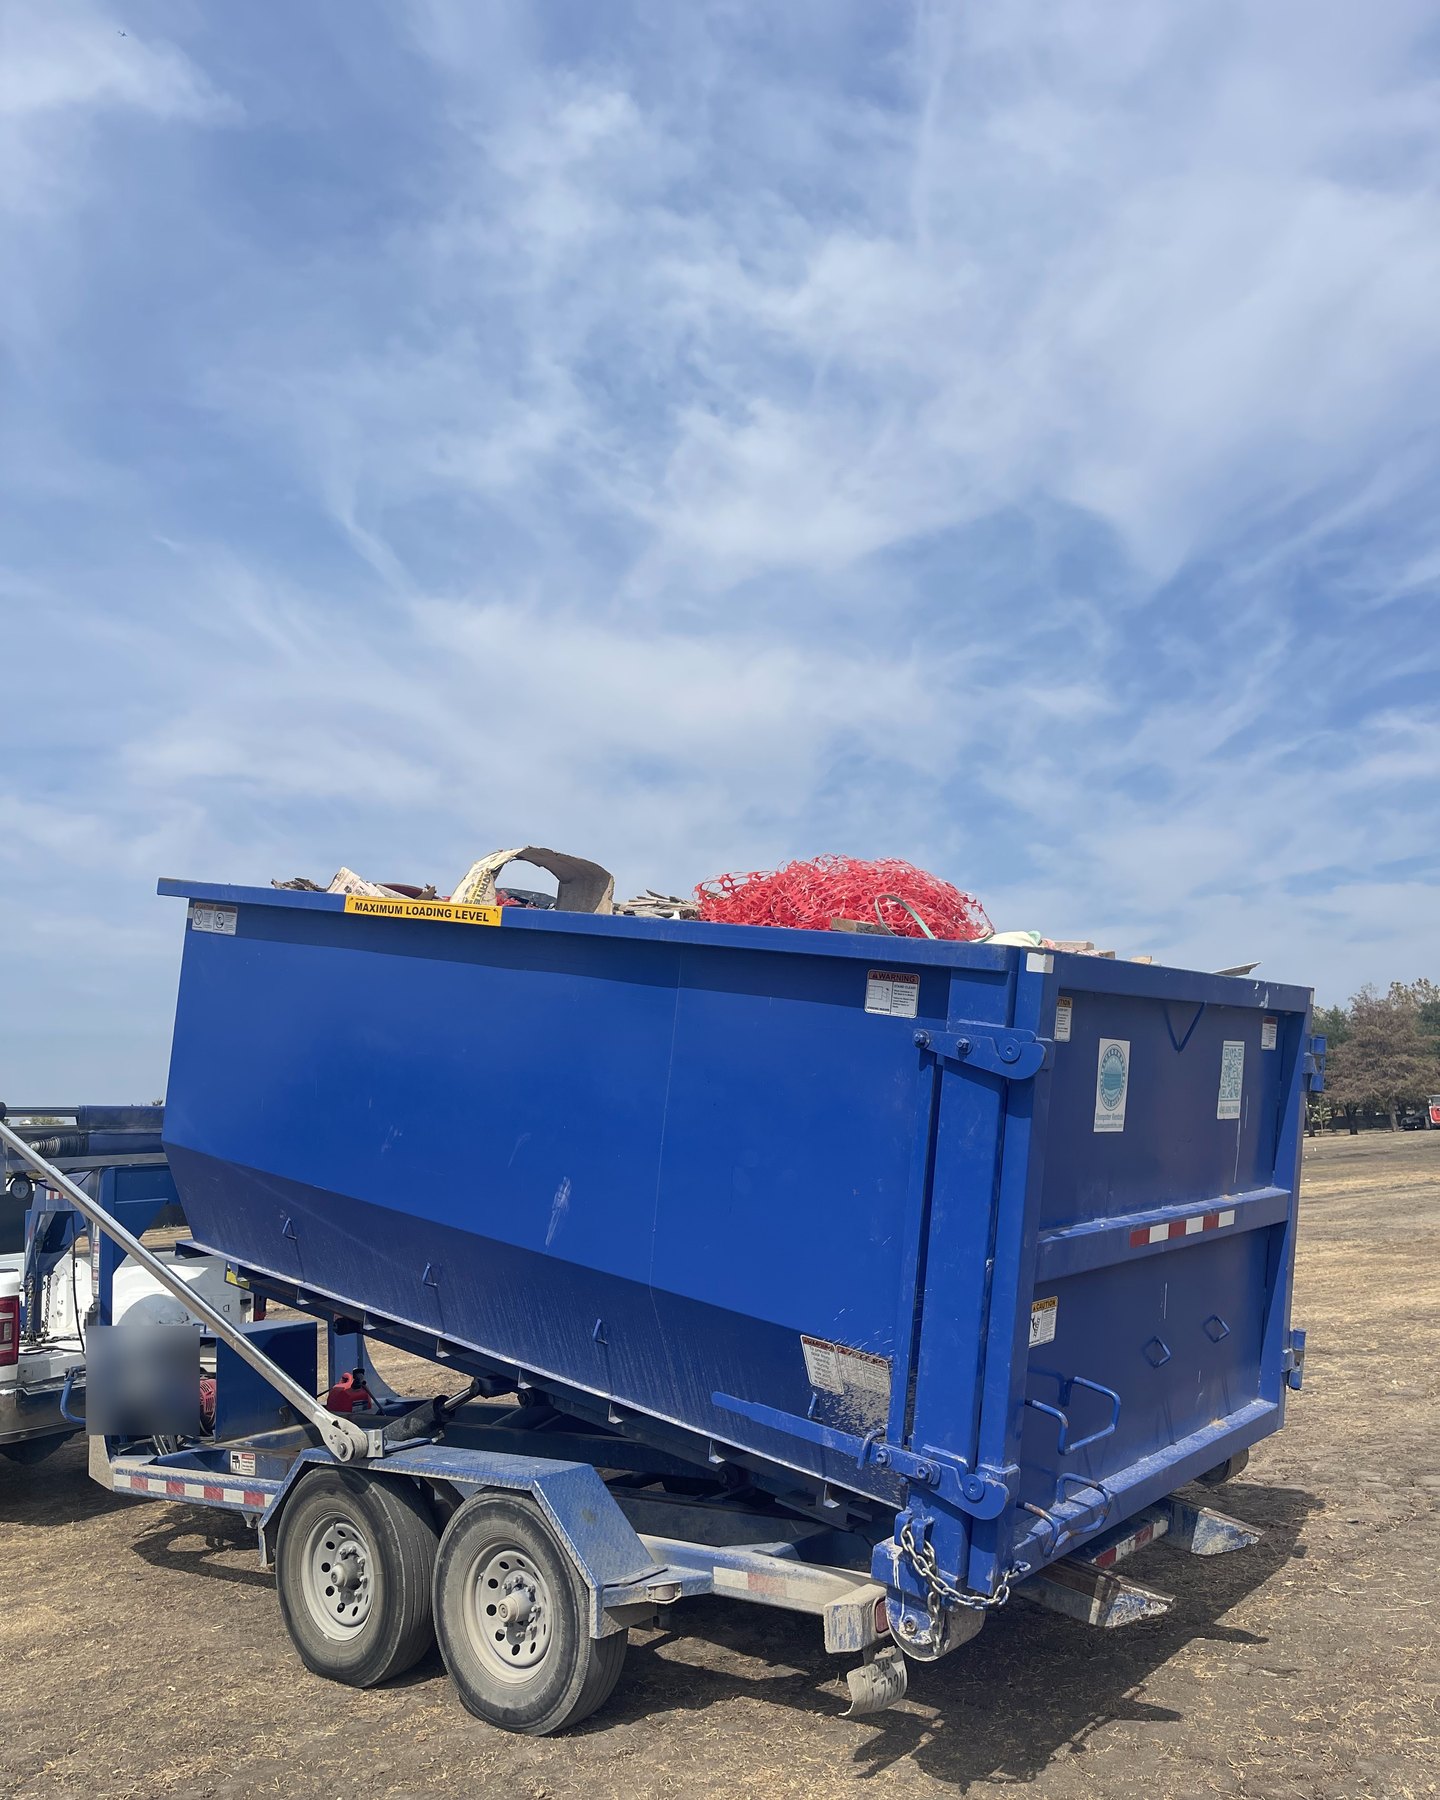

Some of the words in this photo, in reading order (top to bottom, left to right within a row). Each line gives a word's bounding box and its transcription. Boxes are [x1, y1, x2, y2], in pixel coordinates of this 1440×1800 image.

[354, 902, 403, 915] MAXIMUM
[405, 906, 452, 918] LOADING
[455, 910, 489, 922] LEVEL
[879, 972, 918, 983] WARNING
